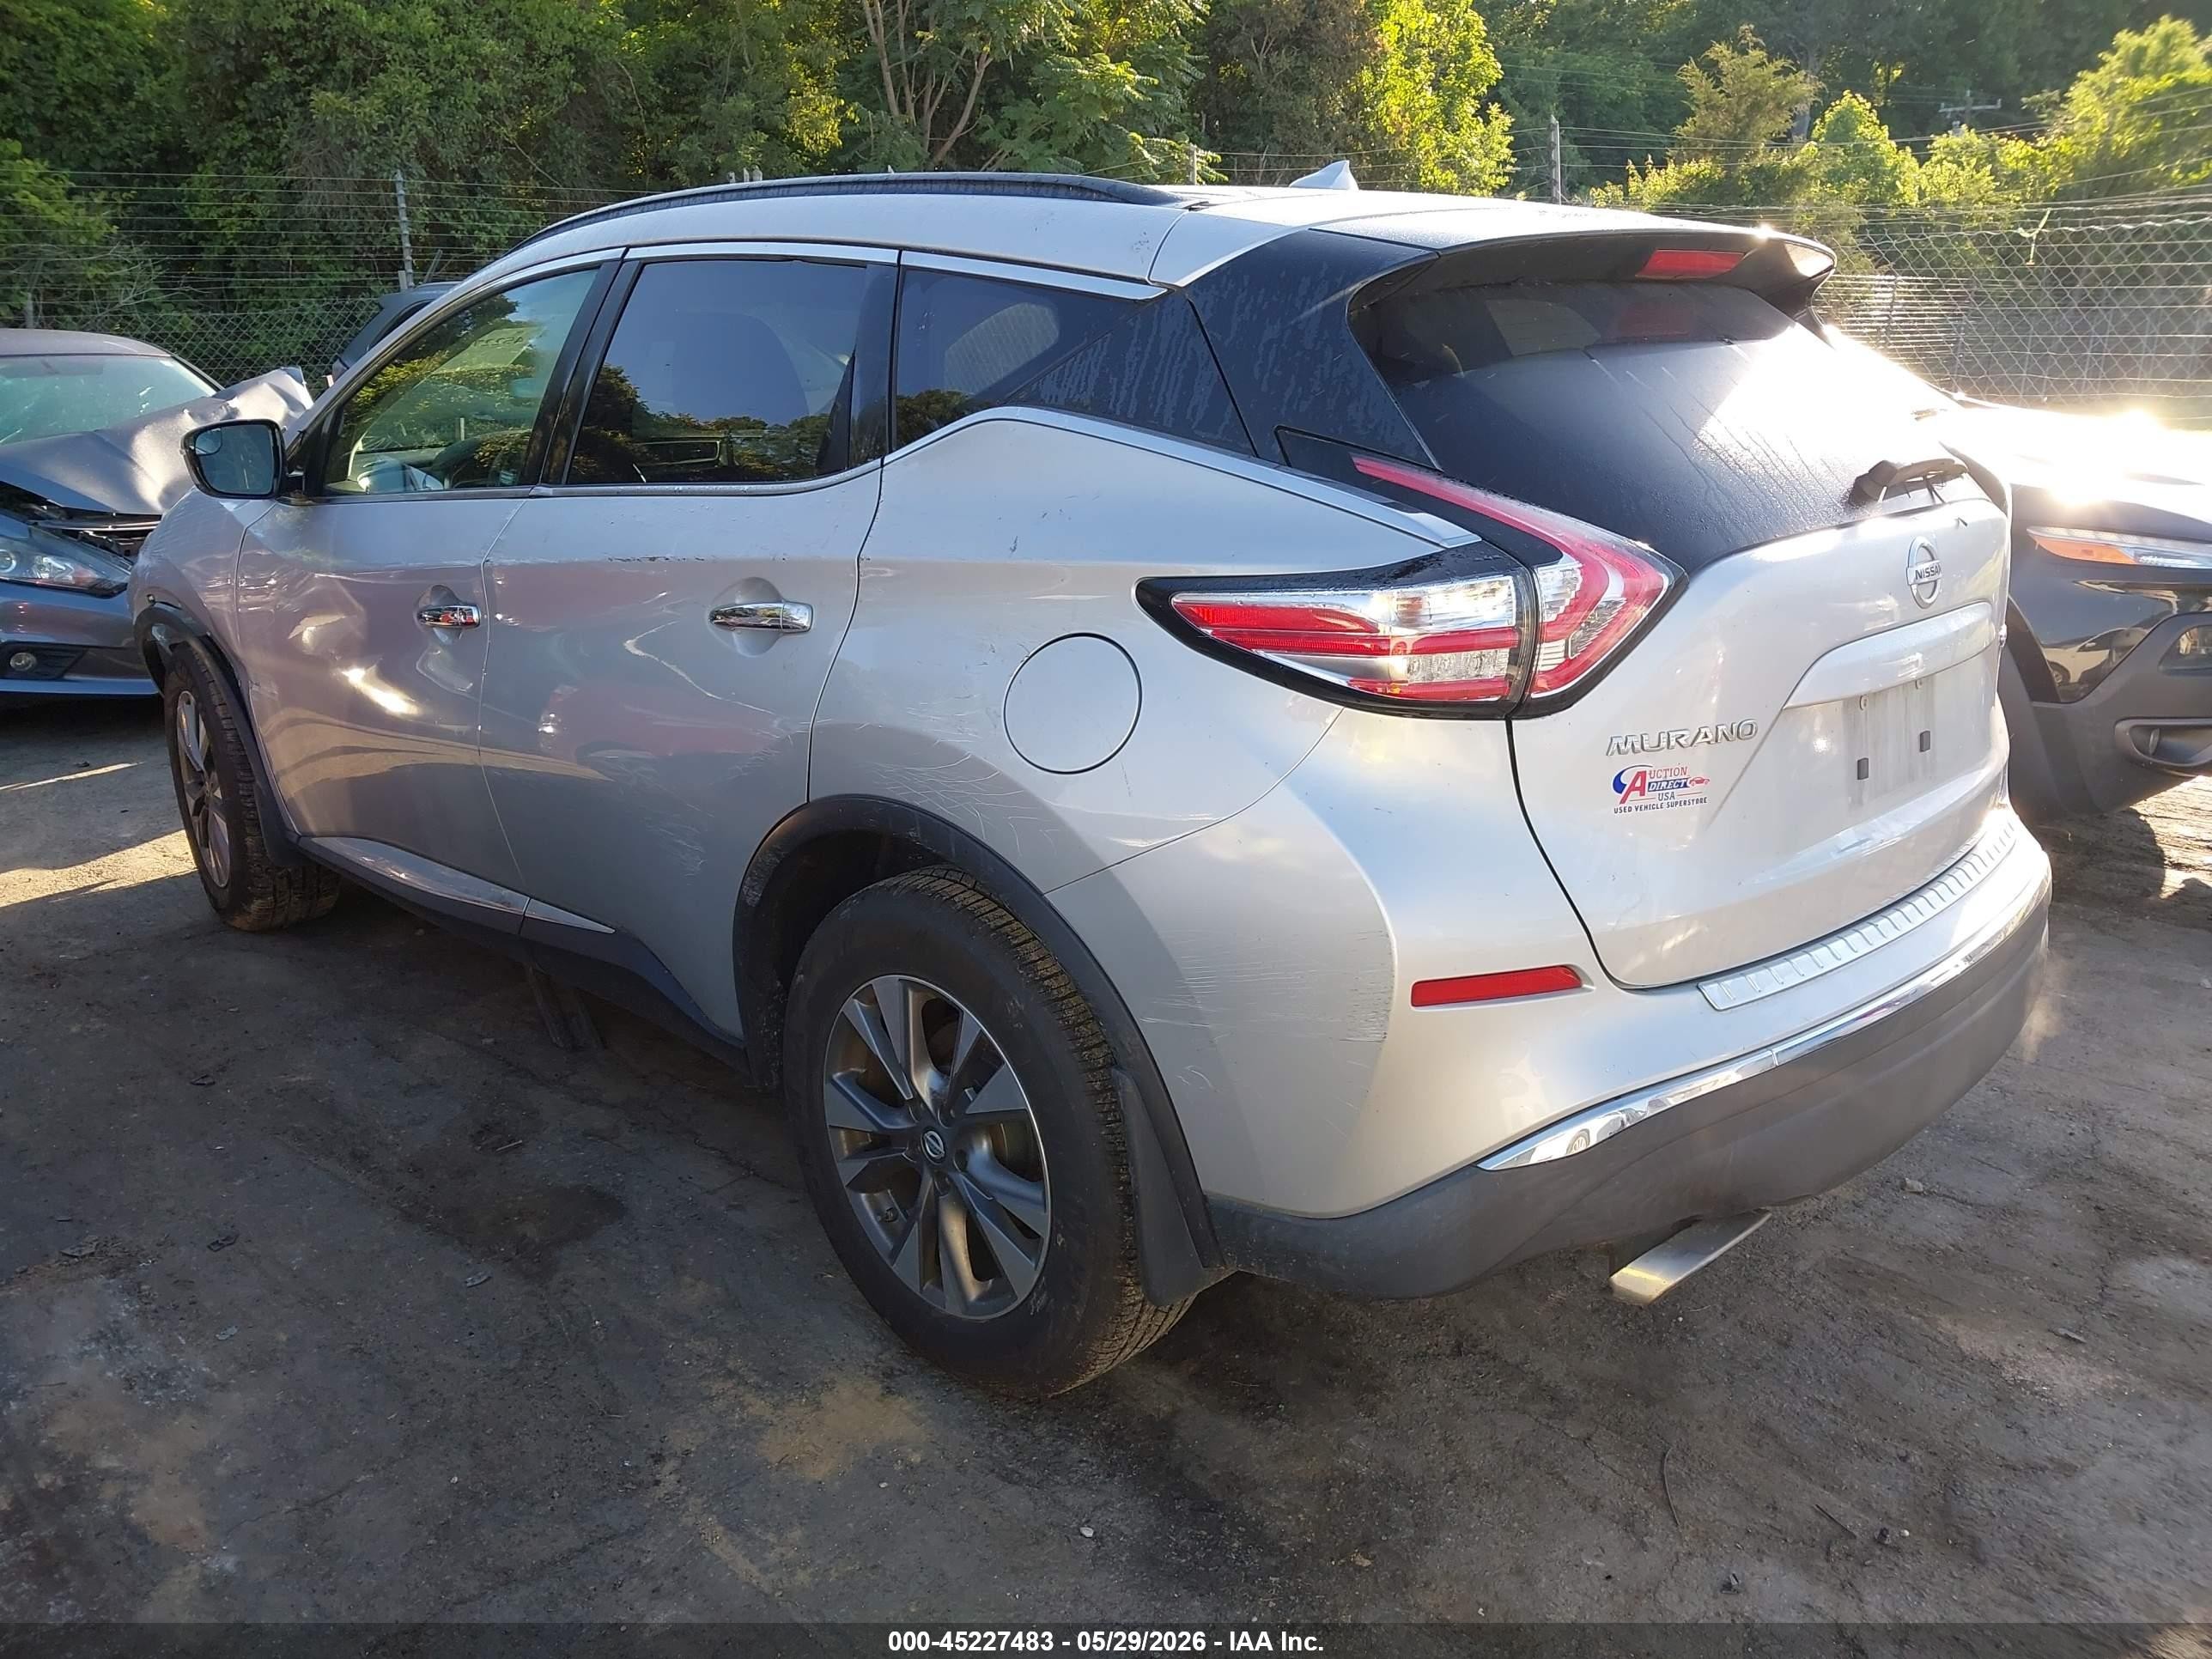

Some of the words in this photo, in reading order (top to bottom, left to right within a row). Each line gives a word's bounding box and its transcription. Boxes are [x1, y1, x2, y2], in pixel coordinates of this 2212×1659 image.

[1606, 718, 1758, 756] MURANO
[1620, 766, 1688, 805] AUCTION
[1648, 779, 1686, 792] DIRECT
[1657, 792, 1675, 801] USA
[1613, 805, 1632, 814] USED
[1634, 803, 1664, 811] VEHICLE
[1666, 797, 1708, 808] SUPERSTORE
